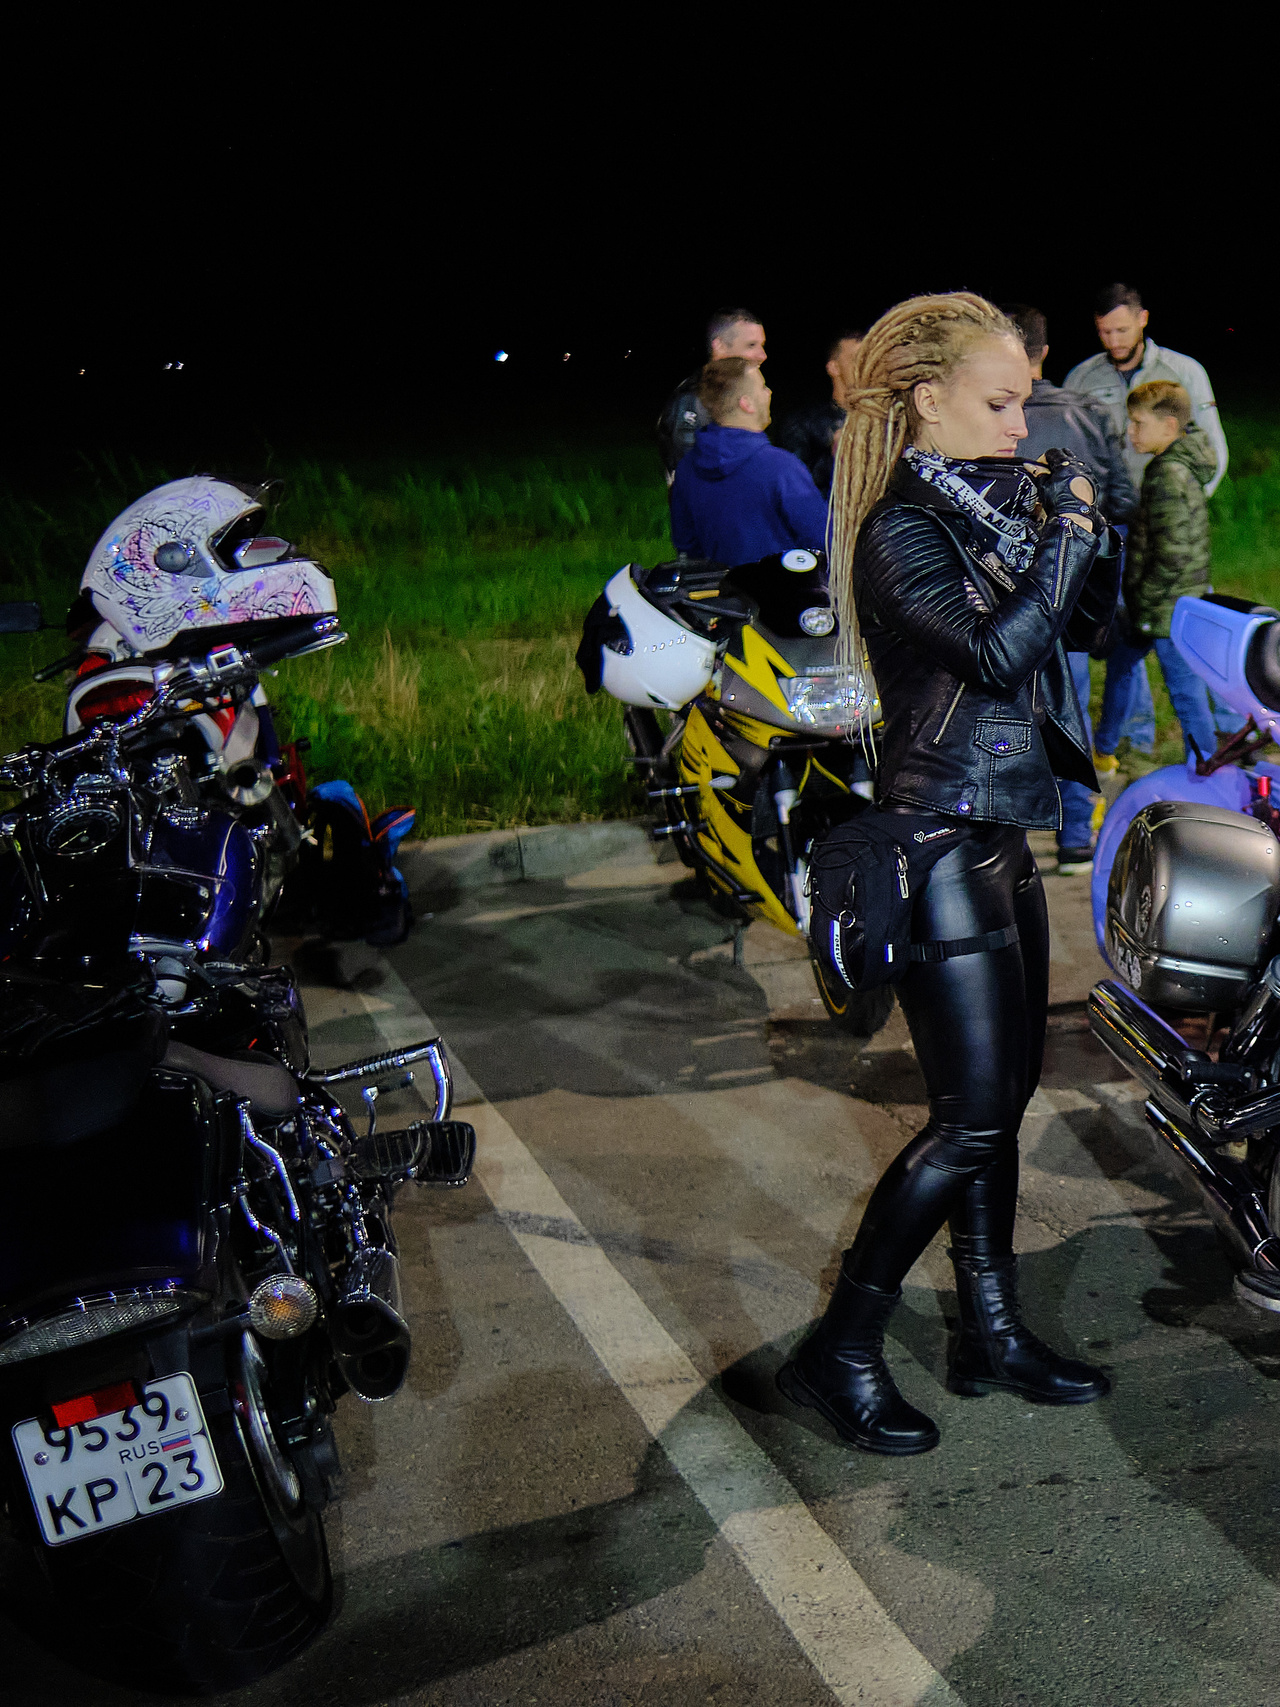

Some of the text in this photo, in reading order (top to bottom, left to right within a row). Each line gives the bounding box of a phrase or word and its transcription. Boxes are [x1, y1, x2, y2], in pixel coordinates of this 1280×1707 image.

[44, 1391, 171, 1463] 9539
[119, 1441, 160, 1464] RUS
[141, 1450, 205, 1505] 23
